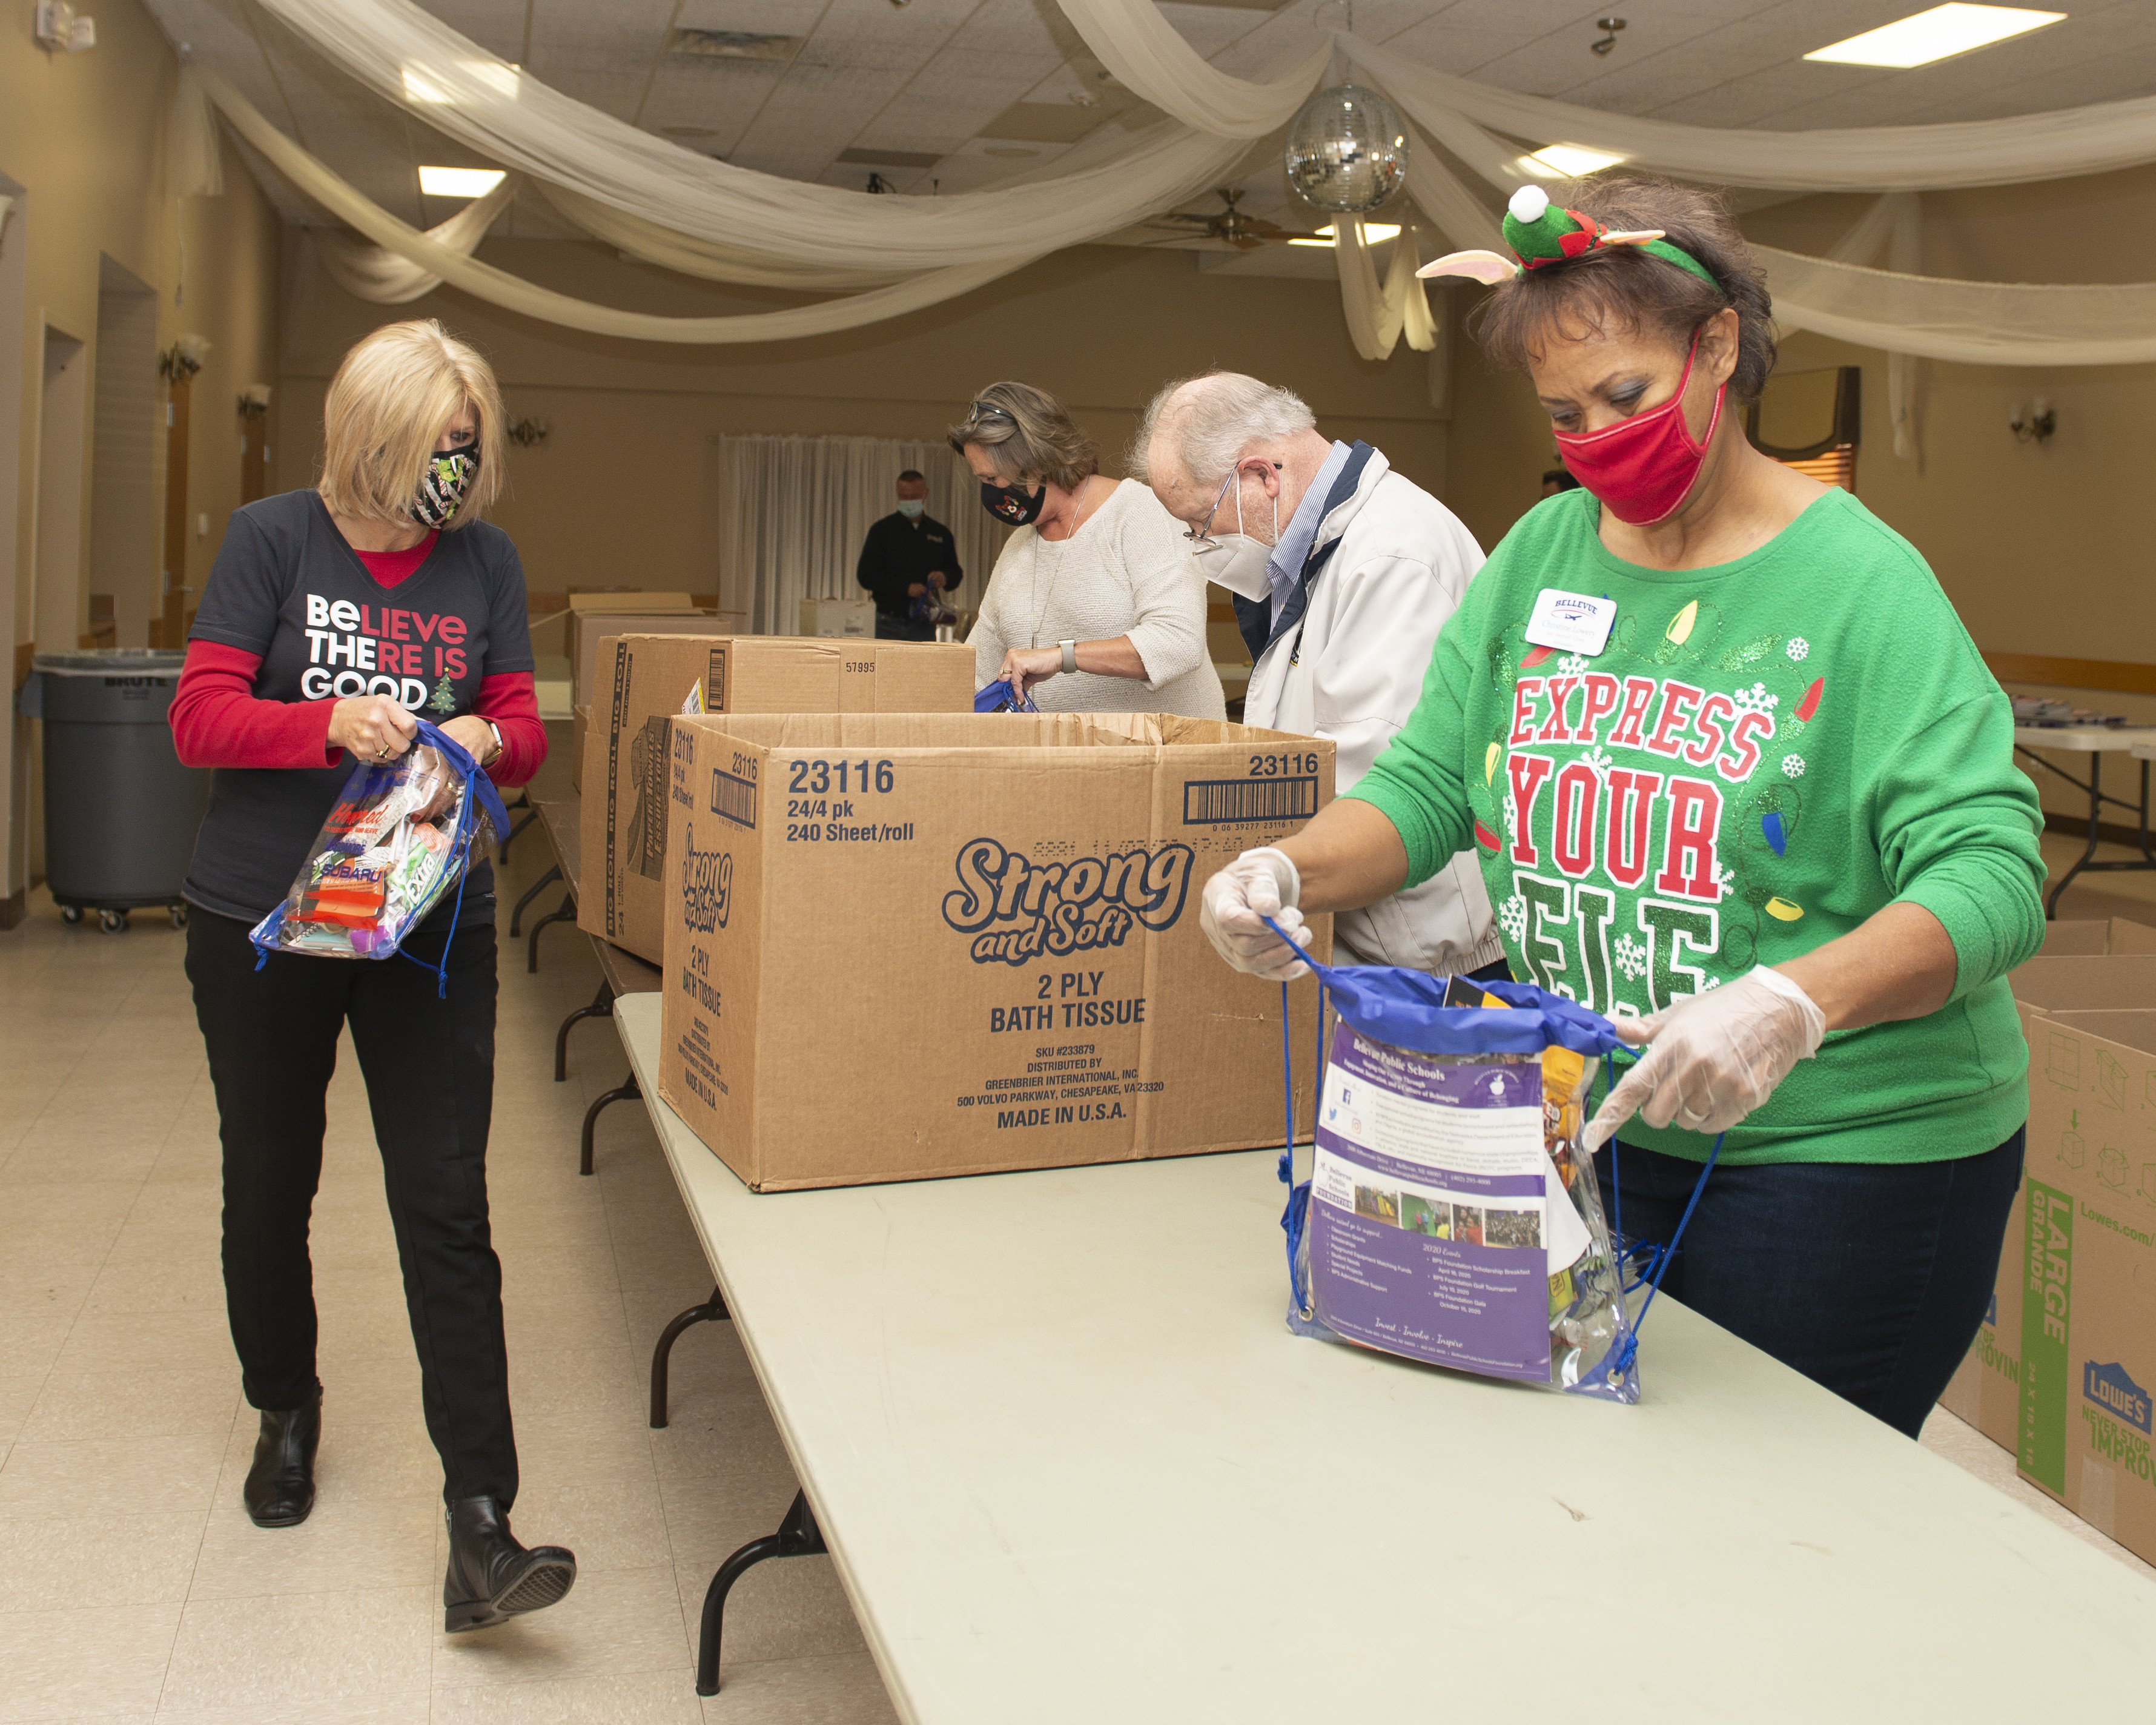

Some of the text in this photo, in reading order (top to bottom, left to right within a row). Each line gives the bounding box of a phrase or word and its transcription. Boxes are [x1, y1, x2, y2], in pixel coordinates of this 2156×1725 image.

[1555, 600, 1598, 614] BELLEVUE
[305, 629, 467, 680] THERE IS
[615, 643, 626, 692] ROLL
[846, 662, 875, 672] 57995
[301, 667, 428, 710] GOOD
[1507, 671, 1776, 783] EXPRESS
[674, 728, 693, 765] 23116
[732, 751, 757, 780] 23116
[789, 760, 894, 793] 23116
[1249, 753, 1319, 776] 23116
[787, 800, 854, 819] 24/4 pk
[787, 823, 914, 843] 240 Sheet/roll
[1506, 752, 1724, 904] YOUR
[321, 863, 382, 882] SUBARU
[683, 821, 733, 929] Strong
[942, 837, 1195, 933] Strong
[618, 910, 624, 936] 24
[696, 888, 716, 935] Soft
[970, 904, 1134, 967] and Soft
[691, 945, 709, 978] 2 PLY
[683, 966, 721, 1018] BATH TISSUE
[1037, 972, 1105, 999] 2 PLY
[990, 998, 1146, 1033] BATH TISSUE
[1035, 1044, 1095, 1058] SKU #233879
[1027, 1058, 1102, 1073] DISTRIBUTED BY
[1381, 1051, 1406, 1071] Public
[1406, 1061, 1446, 1082] Schools
[686, 1067, 698, 1094] MADE
[698, 1079, 703, 1099] IN
[985, 1069, 1139, 1090] GREENBRIER INTERNATIONAL, INC.
[957, 1081, 1164, 1107] 500 VOLVO PARKWAY, CHESAPEAKE, VA 23320
[997, 1102, 1127, 1129] MADE IN U.S.A.
[1328, 1174, 1346, 1188] Public
[1329, 1166, 1352, 1182] Bellevue
[1316, 1187, 1352, 1209] FOUNDATION
[1328, 1183, 1350, 1197] Schools
[2080, 1201, 2156, 1247] Lowes.com/
[1423, 1243, 1442, 1254] 2020
[2030, 1189, 2045, 1294] GRANDE
[1432, 1256, 1443, 1265] BPS
[1443, 1259, 1472, 1271] Foundation
[1472, 1264, 1504, 1276] Scholarship
[1438, 1266, 1450, 1275] April
[1458, 1271, 1472, 1279] 2020
[2043, 1195, 2070, 1344] LARGE
[1433, 1274, 1444, 1283] BPS
[1444, 1276, 1472, 1288] Foundation
[1484, 1283, 1517, 1293] Tournament
[1439, 1284, 1449, 1293] July
[1456, 1288, 1470, 1296] 2020
[1433, 1291, 1487, 1308] BPS Foundation Gala
[1439, 1302, 1460, 1311] October
[1467, 1307, 1481, 1316] 2020
[1375, 1317, 1464, 1349] Invest Involve Inspire
[2090, 1369, 2146, 1424] LOWE'S
[2082, 1404, 2151, 1454] NEVER STOP
